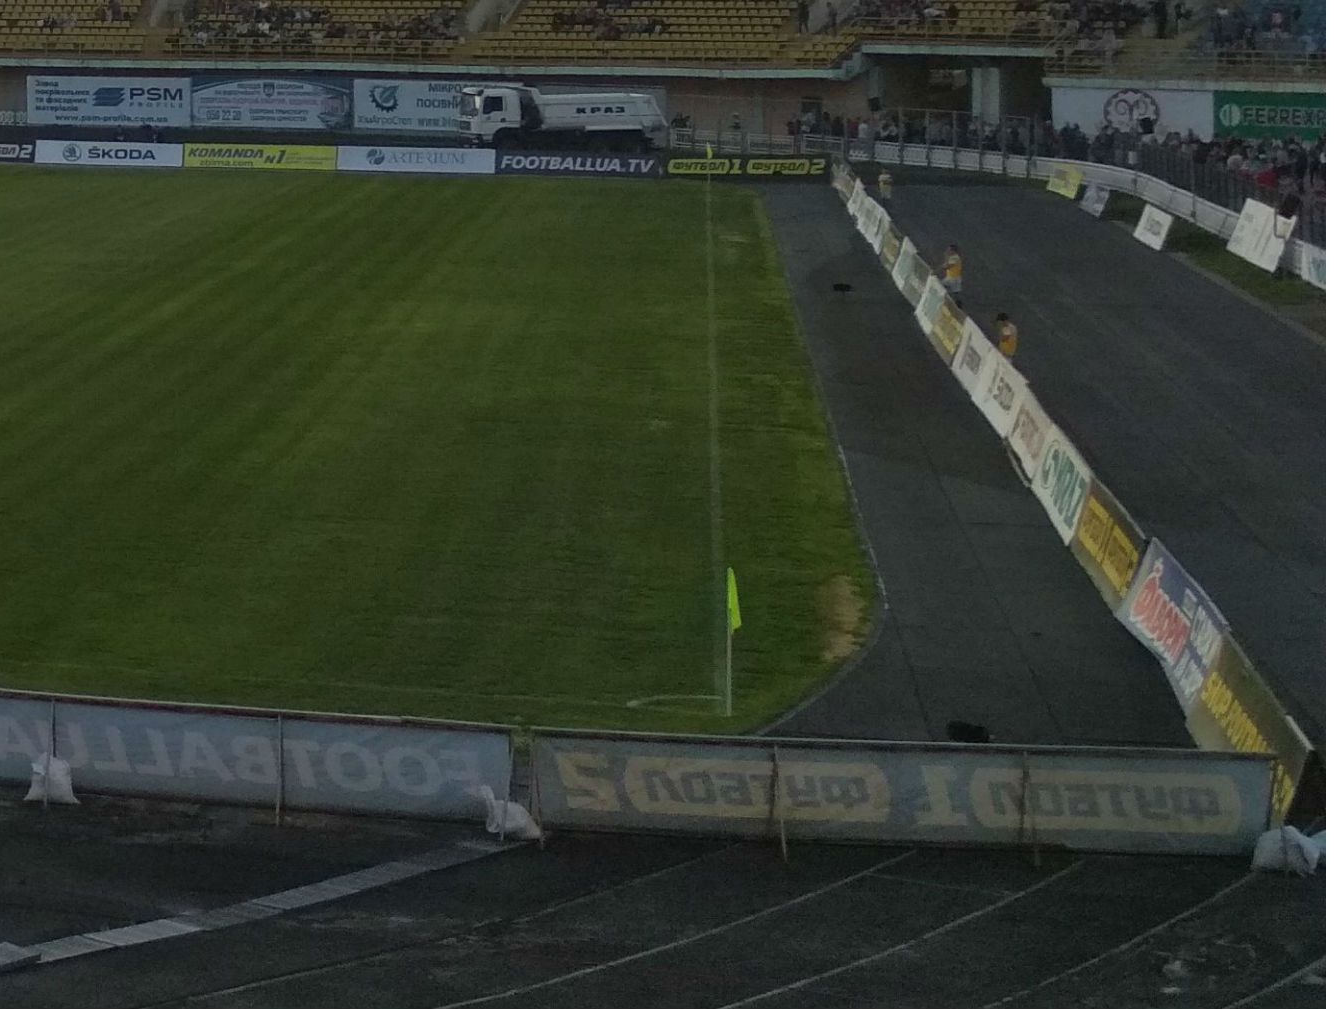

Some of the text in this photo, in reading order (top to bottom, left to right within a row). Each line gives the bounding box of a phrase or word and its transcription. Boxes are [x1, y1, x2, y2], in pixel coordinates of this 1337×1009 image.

[129, 87, 183, 101] PSM
[576, 105, 625, 115] КРАЗ
[19, 144, 33, 159] 2
[87, 145, 156, 160] ŠKODA
[188, 147, 264, 159] KOMANDA
[388, 151, 466, 166] ARTERIUM
[500, 154, 655, 174] FOOTBALLUA.TV
[672, 158, 826, 175] ФУТБОЛ 1 ФУТБОЛ 2
